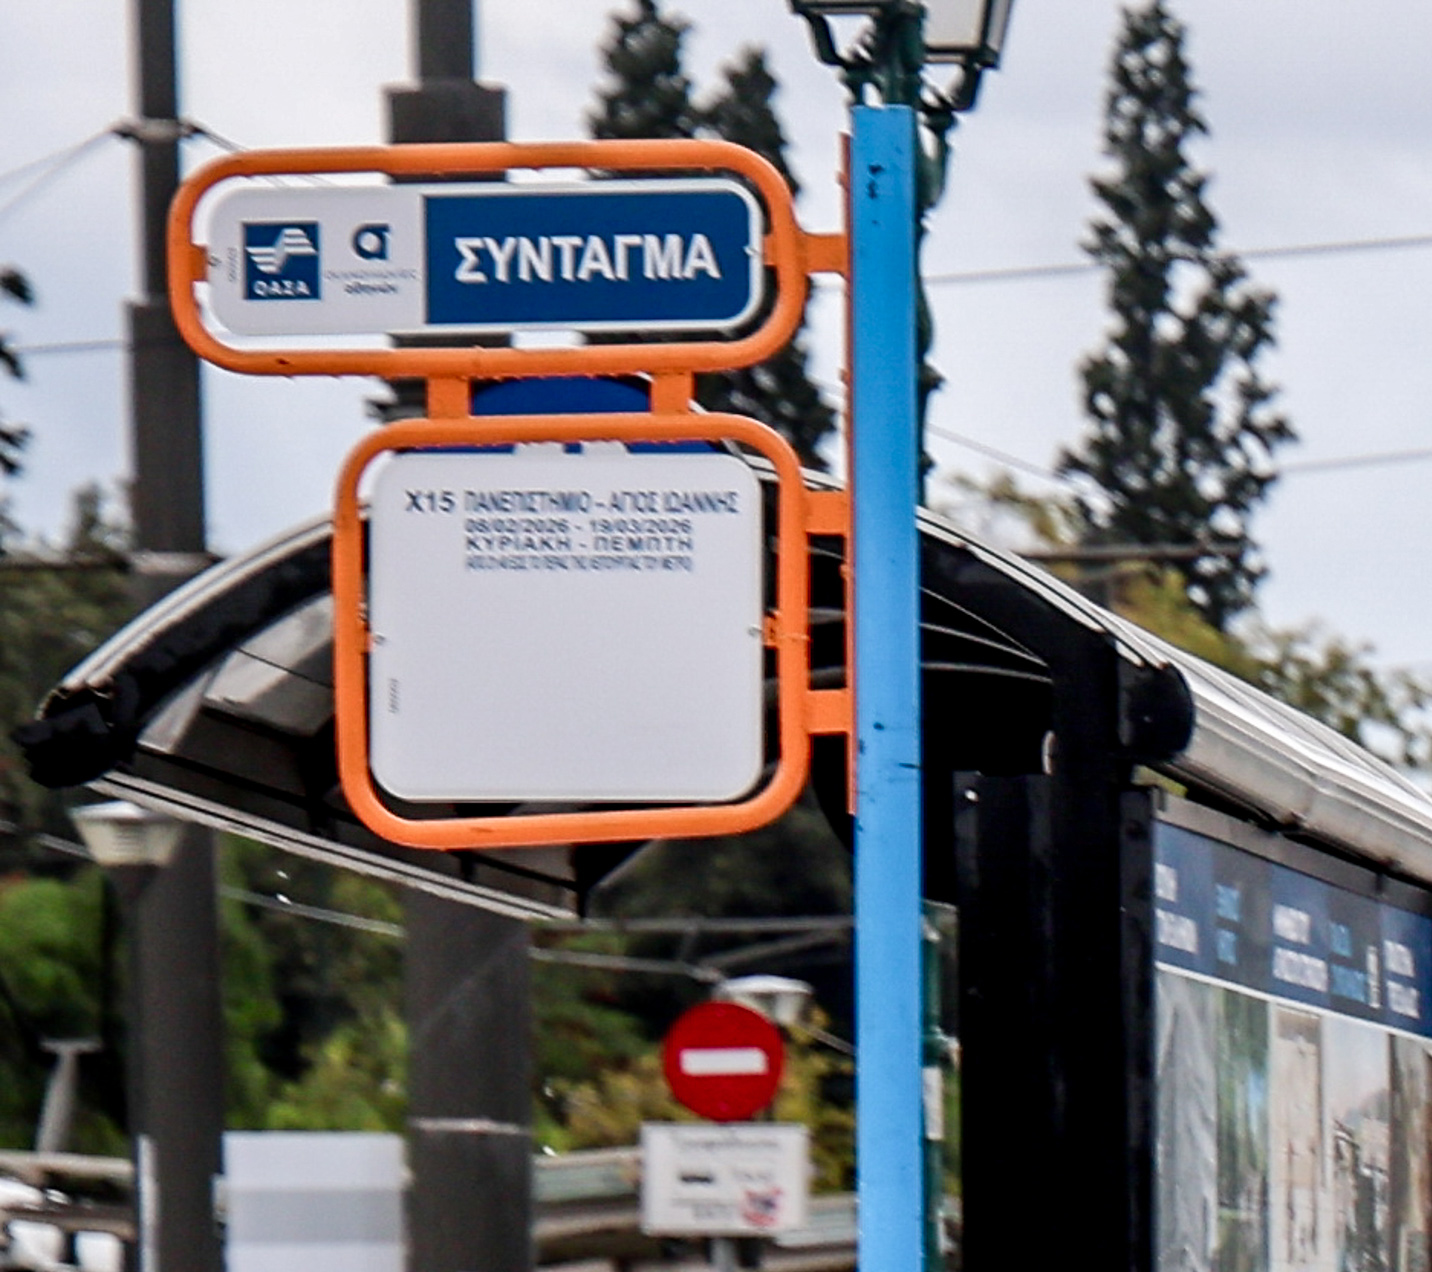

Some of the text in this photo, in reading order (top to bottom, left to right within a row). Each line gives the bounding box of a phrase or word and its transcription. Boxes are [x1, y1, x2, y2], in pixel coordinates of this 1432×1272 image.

[454, 233, 722, 283] ΣΥΝΤΑΓΜΑ
[466, 536, 572, 550] ΚΥΡΙΑΚΗ
[593, 536, 693, 551] ΠΕΜΠΤΗ
